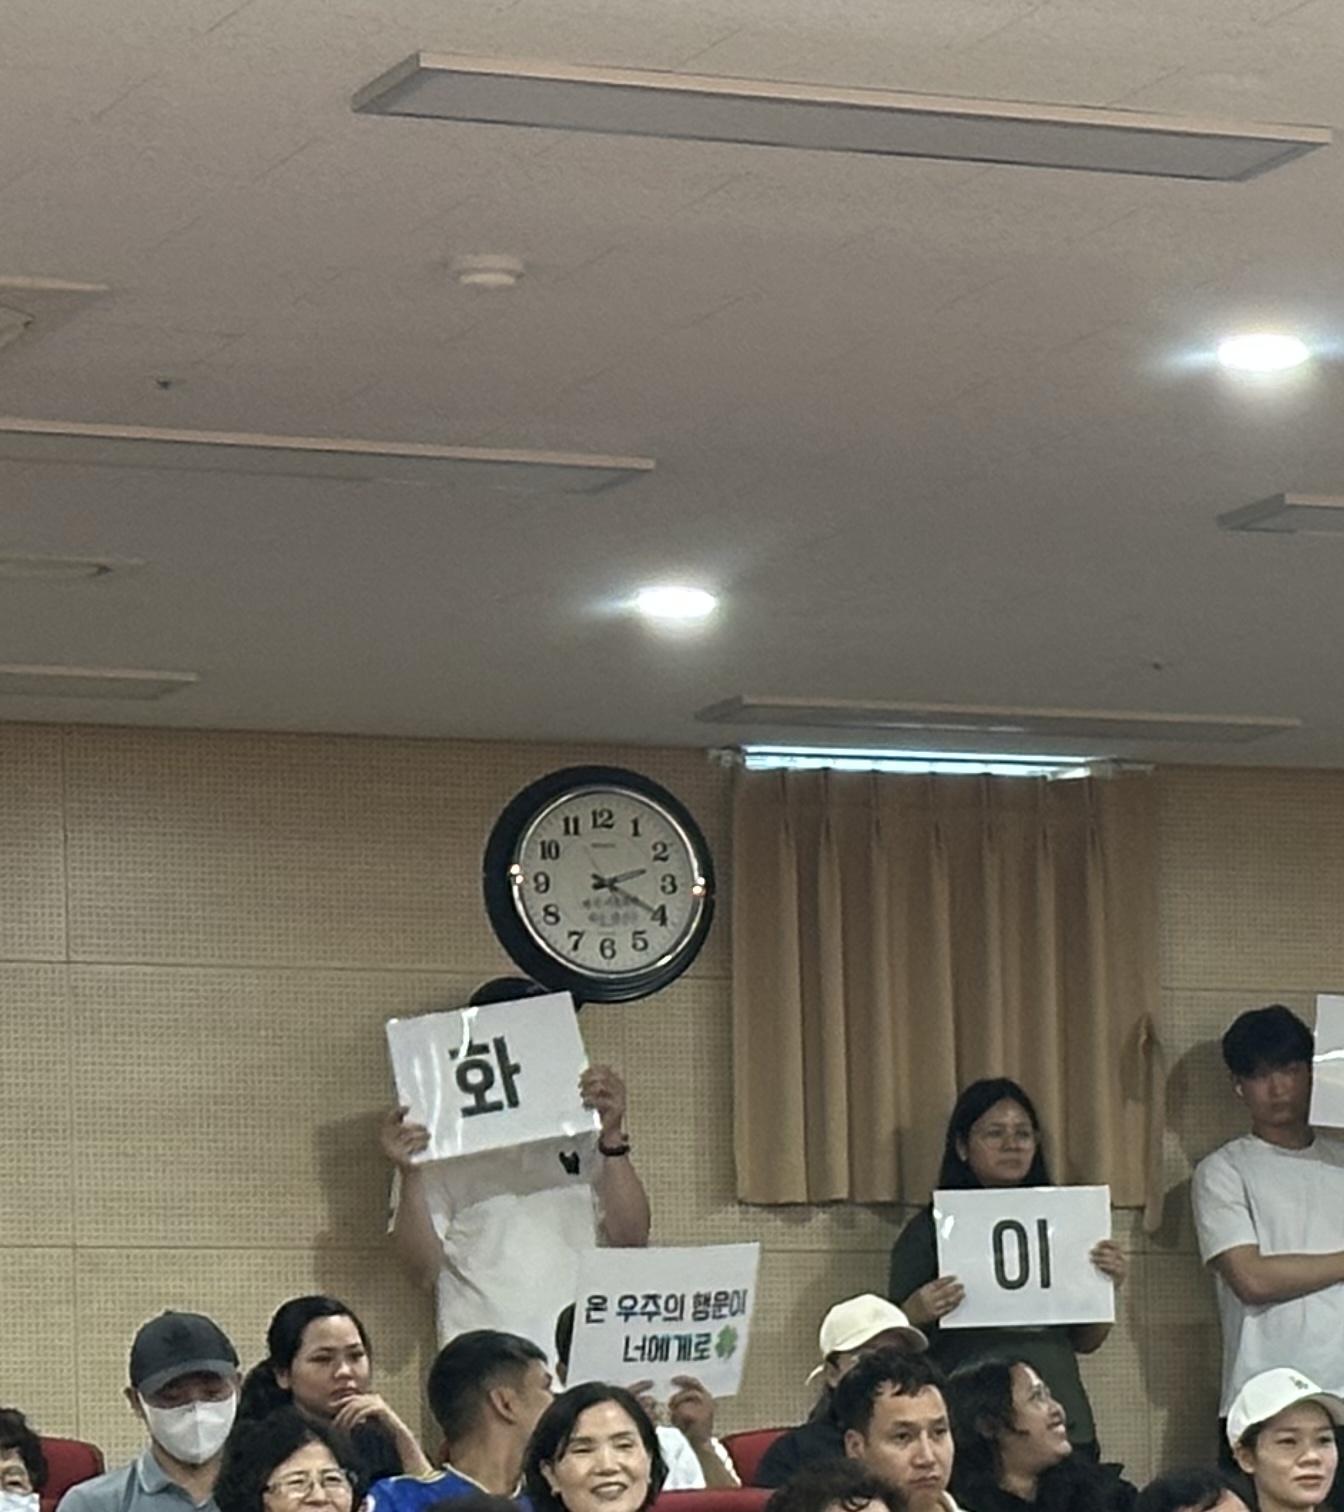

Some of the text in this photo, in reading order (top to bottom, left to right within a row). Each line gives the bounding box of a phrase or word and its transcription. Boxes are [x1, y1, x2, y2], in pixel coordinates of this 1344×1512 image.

[562, 816, 580, 836] 11
[591, 809, 615, 830] 12
[630, 817, 641, 837] 1
[538, 839, 560, 861] 10
[652, 842, 669, 862] 2
[533, 872, 549, 894] 9
[660, 873, 677, 895] 3
[542, 903, 561, 925] 8
[651, 904, 668, 927] 4
[567, 930, 585, 951] 7
[600, 938, 616, 960] 6
[631, 931, 648, 951] 5
[448, 1035, 521, 1118] 화
[992, 1219, 1051, 1290] 이
[616, 1293, 686, 1323] 우주의
[692, 1289, 748, 1322] 행운이
[623, 1332, 712, 1363] 너에게로
